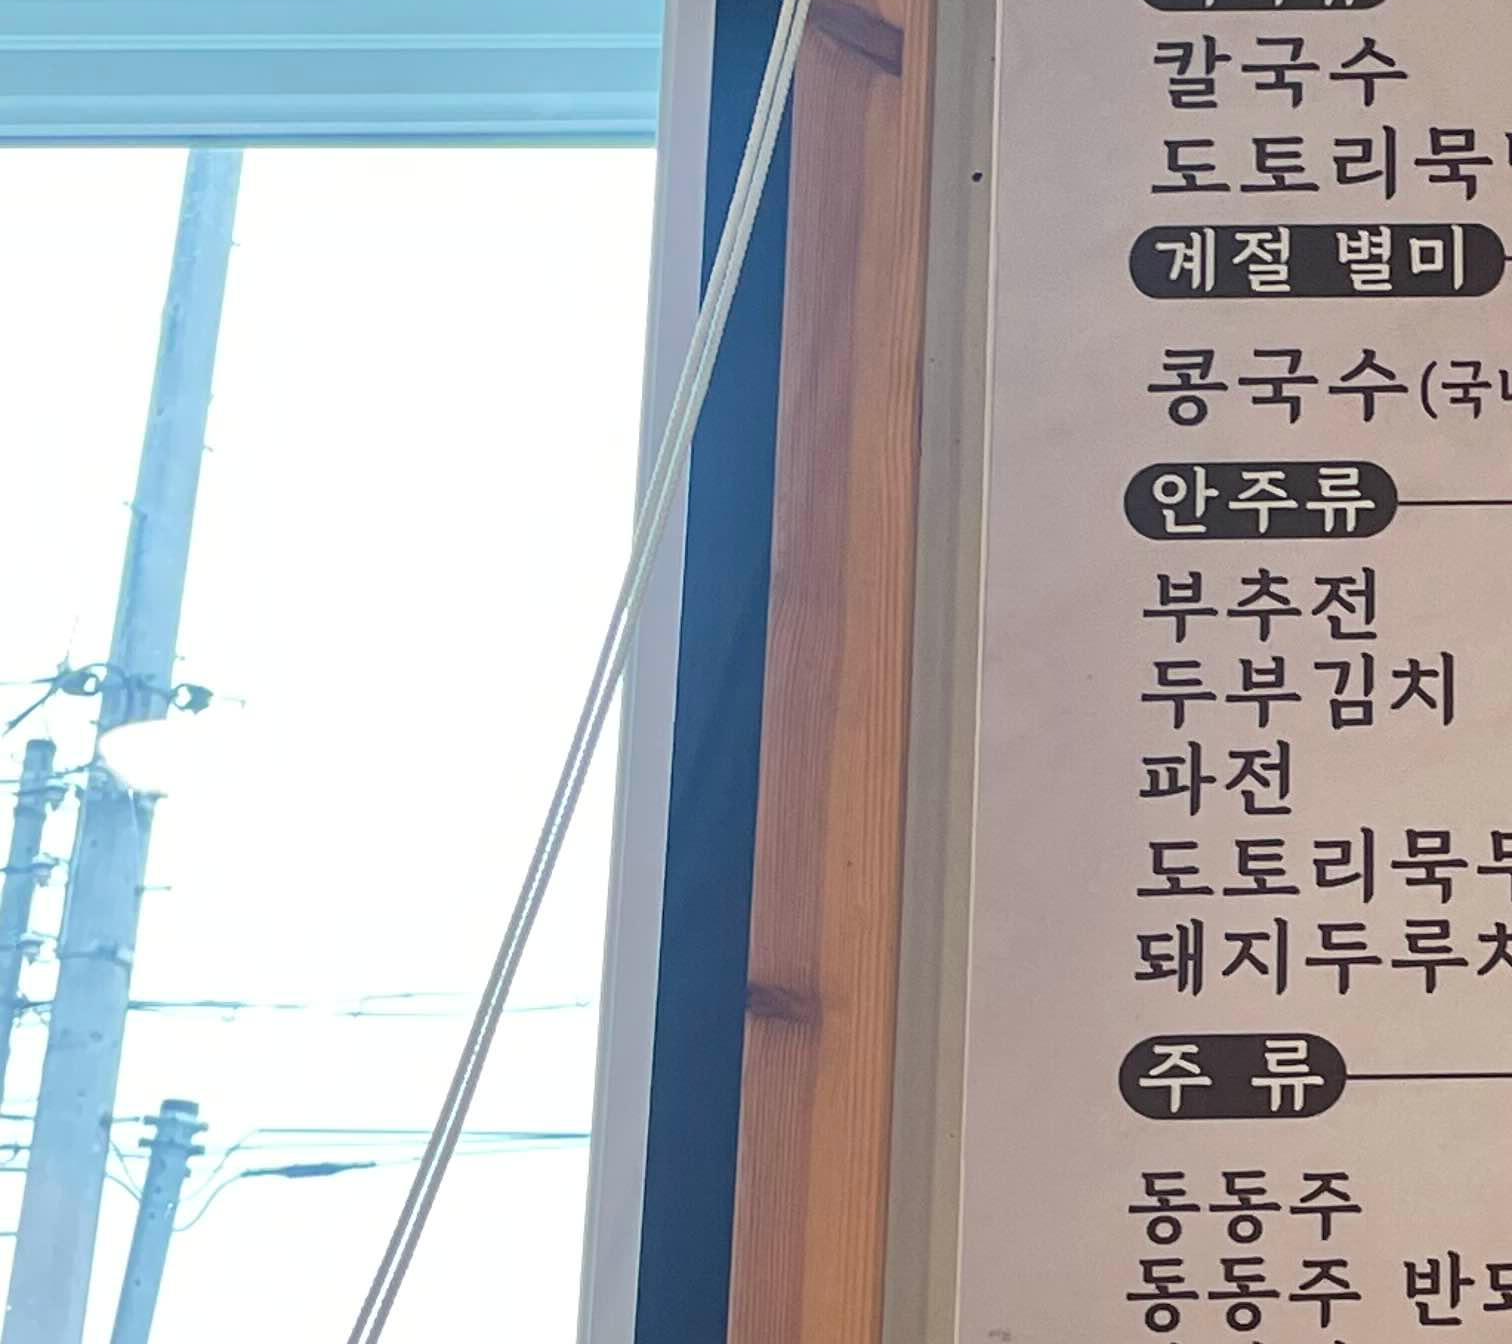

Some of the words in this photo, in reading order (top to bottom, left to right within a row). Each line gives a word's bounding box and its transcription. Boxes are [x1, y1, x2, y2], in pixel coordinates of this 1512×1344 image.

[1154, 35, 1408, 108] 칼국수
[1154, 225, 1292, 293] 계절
[1336, 224, 1467, 292] 별미
[1152, 467, 1376, 534] 안주류
[1143, 567, 1377, 643] 부추전
[1141, 652, 1453, 729] 두부김치
[1139, 740, 1291, 816] 파전
[1129, 1171, 1362, 1244] 동동주
[1126, 1257, 1361, 1332] 동동주
